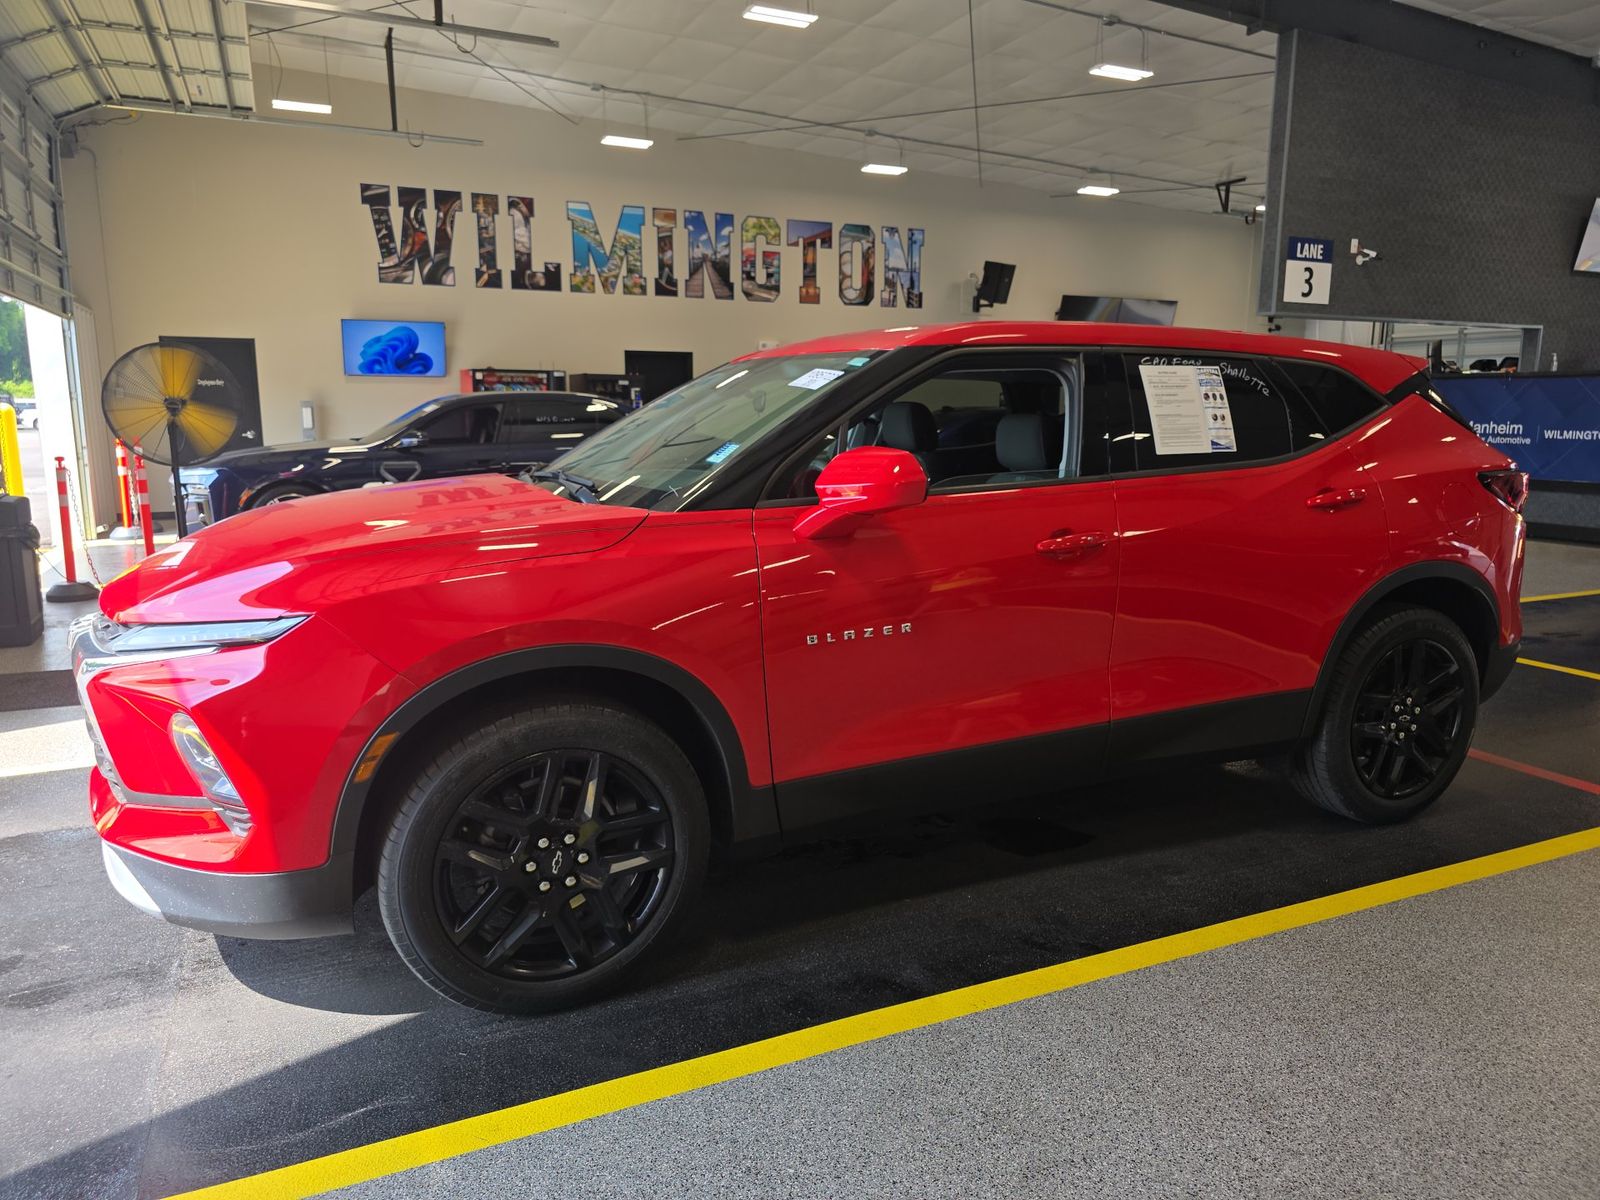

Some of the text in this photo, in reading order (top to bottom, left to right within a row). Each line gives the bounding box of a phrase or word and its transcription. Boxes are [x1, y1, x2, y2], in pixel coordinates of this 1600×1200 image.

[360, 183, 925, 309] WILMINGTON
[1296, 242, 1324, 260] LANE
[1301, 266, 1314, 298] 3
[1486, 435, 1531, 445] Automotive
[806, 622, 912, 645] BLAZER
